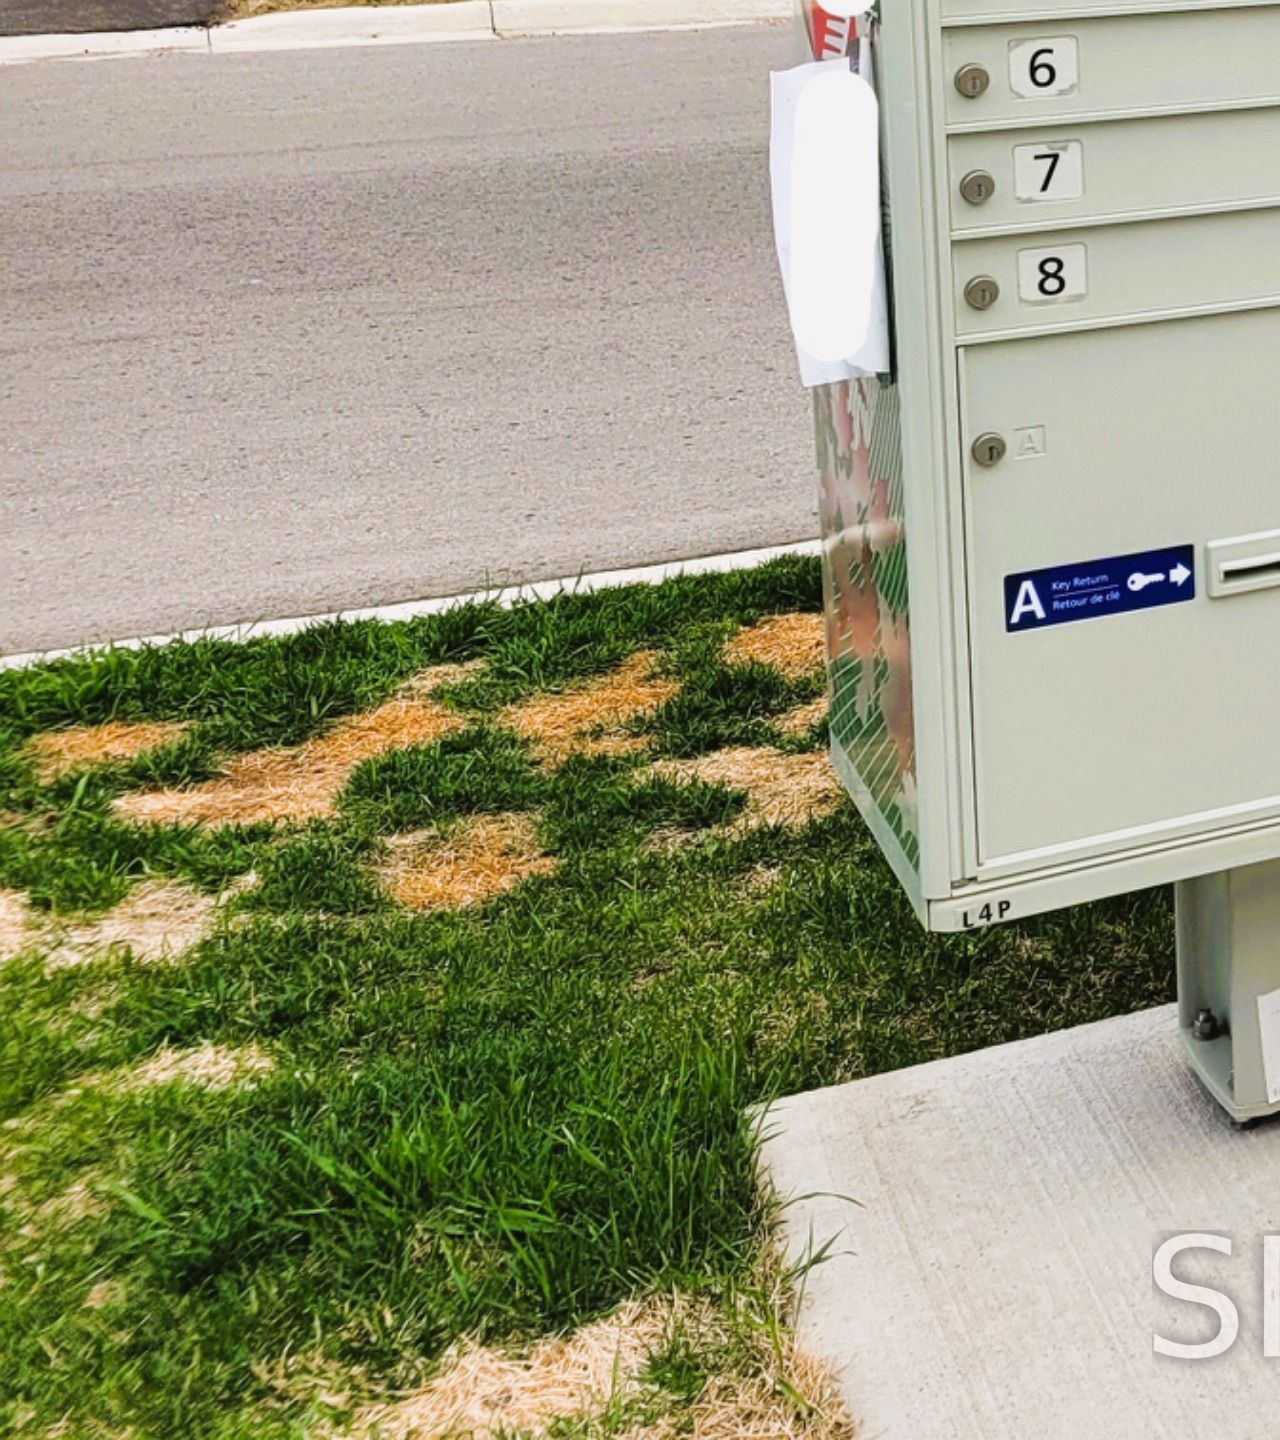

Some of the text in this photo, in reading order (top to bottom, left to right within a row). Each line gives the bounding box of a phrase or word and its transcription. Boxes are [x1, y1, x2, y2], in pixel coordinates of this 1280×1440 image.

[1030, 49, 1055, 87] 6
[1034, 153, 1059, 191] 7
[1038, 257, 1065, 295] 8
[1010, 580, 1046, 623] A
[1051, 574, 1109, 592] Key Return
[1053, 590, 1121, 610] Retour de clé
